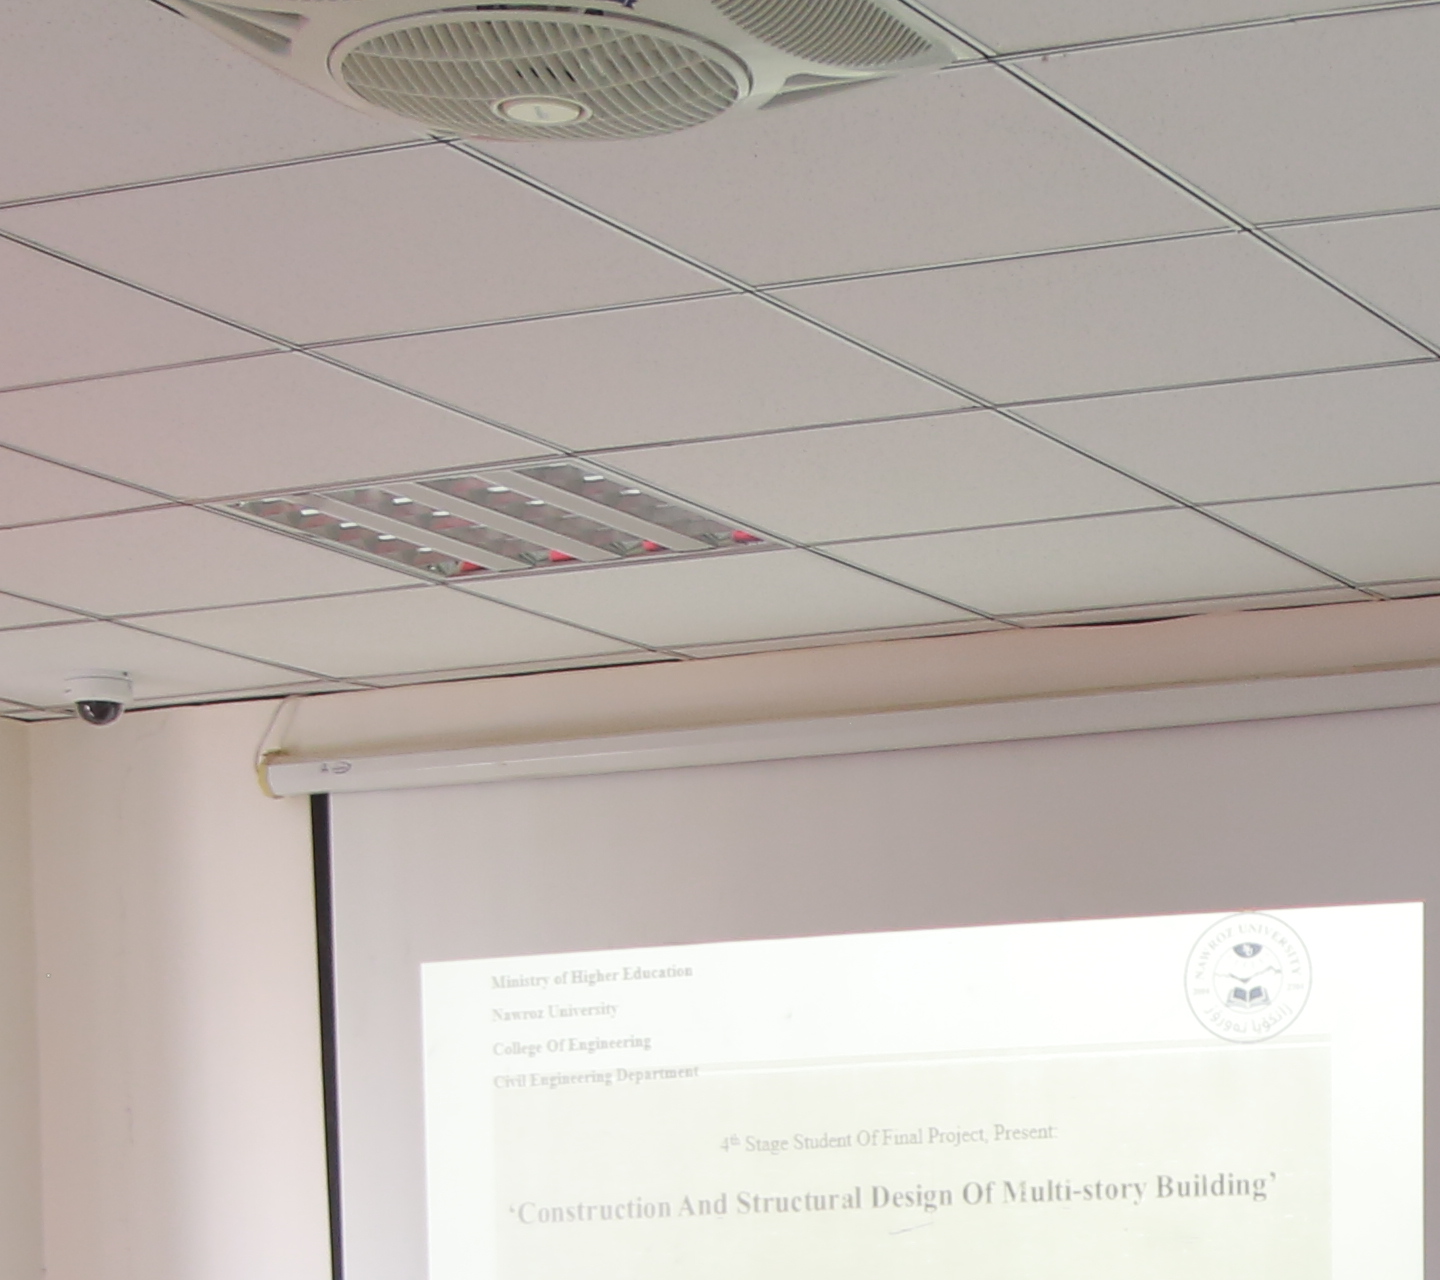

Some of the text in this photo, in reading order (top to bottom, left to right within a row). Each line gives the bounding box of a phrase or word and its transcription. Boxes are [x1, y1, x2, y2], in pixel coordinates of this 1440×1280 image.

[1194, 923, 1302, 980] NAWROZ UNIVERSITY
[491, 964, 694, 990] Ministry of Higher Education
[492, 1001, 619, 1022] Nawroz University
[493, 1034, 652, 1058] College Of Engineering
[493, 1065, 700, 1090] Civil Engineering Department
[720, 1123, 1059, 1155] 4th Stage Student Of Final Project, Present:
[677, 1192, 728, 1218] And
[736, 1186, 862, 1214] Structural
[872, 1184, 954, 1213] Design
[962, 1181, 997, 1207] Of
[1003, 1178, 1148, 1205] Multi-story
